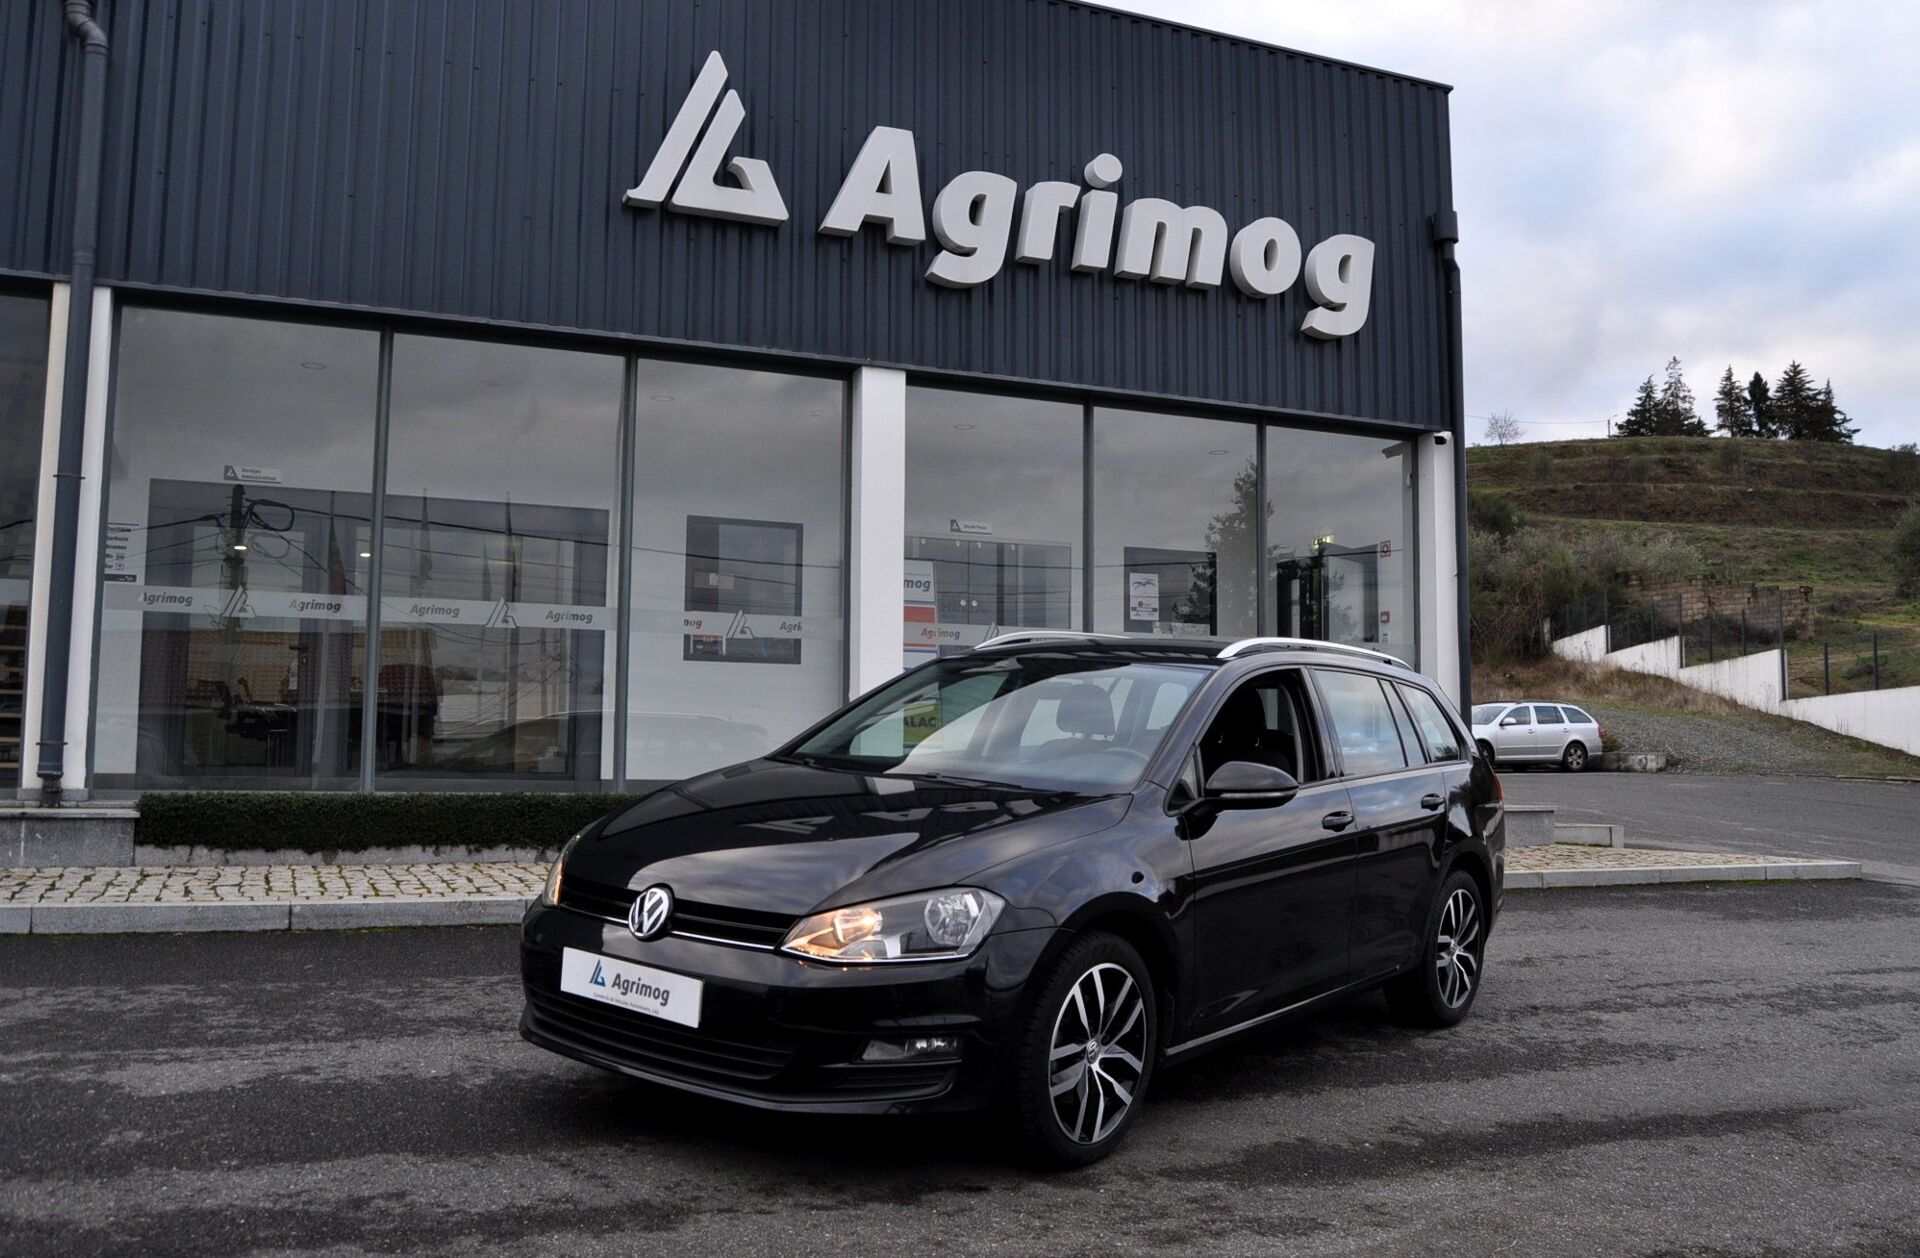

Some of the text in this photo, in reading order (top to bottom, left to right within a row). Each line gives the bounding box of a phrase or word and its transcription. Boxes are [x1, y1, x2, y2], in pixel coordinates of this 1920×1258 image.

[819, 125, 1375, 341] Agrimog
[289, 599, 341, 613] Agrimog
[410, 604, 460, 618] Agrimog
[546, 610, 593, 624] Agrimog
[611, 973, 670, 1007] Agrimog
